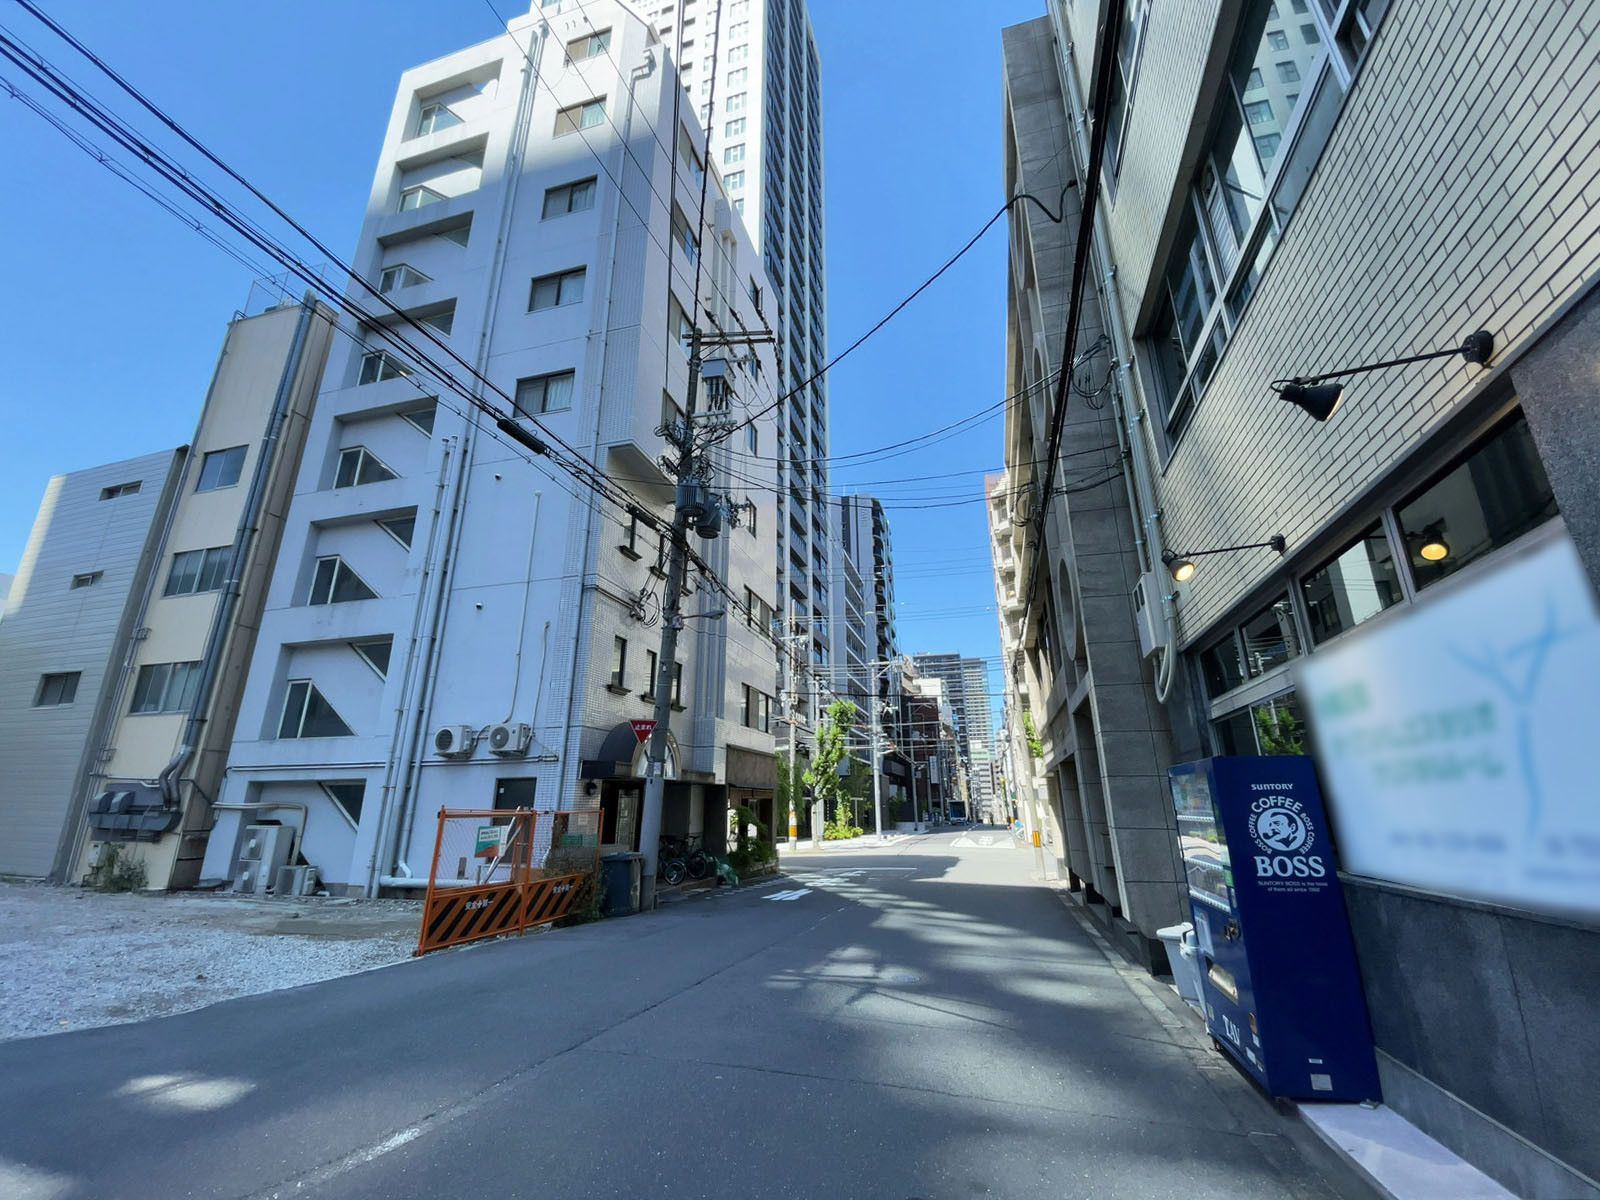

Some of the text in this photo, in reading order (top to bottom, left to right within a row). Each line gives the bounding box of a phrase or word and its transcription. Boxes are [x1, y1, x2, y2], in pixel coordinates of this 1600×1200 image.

[1251, 795, 1303, 813] COFFEE
[1248, 813, 1273, 854] BOSS COFFEE
[1299, 812, 1315, 854] BOSS COFFEE
[1253, 855, 1326, 877] BOSS
